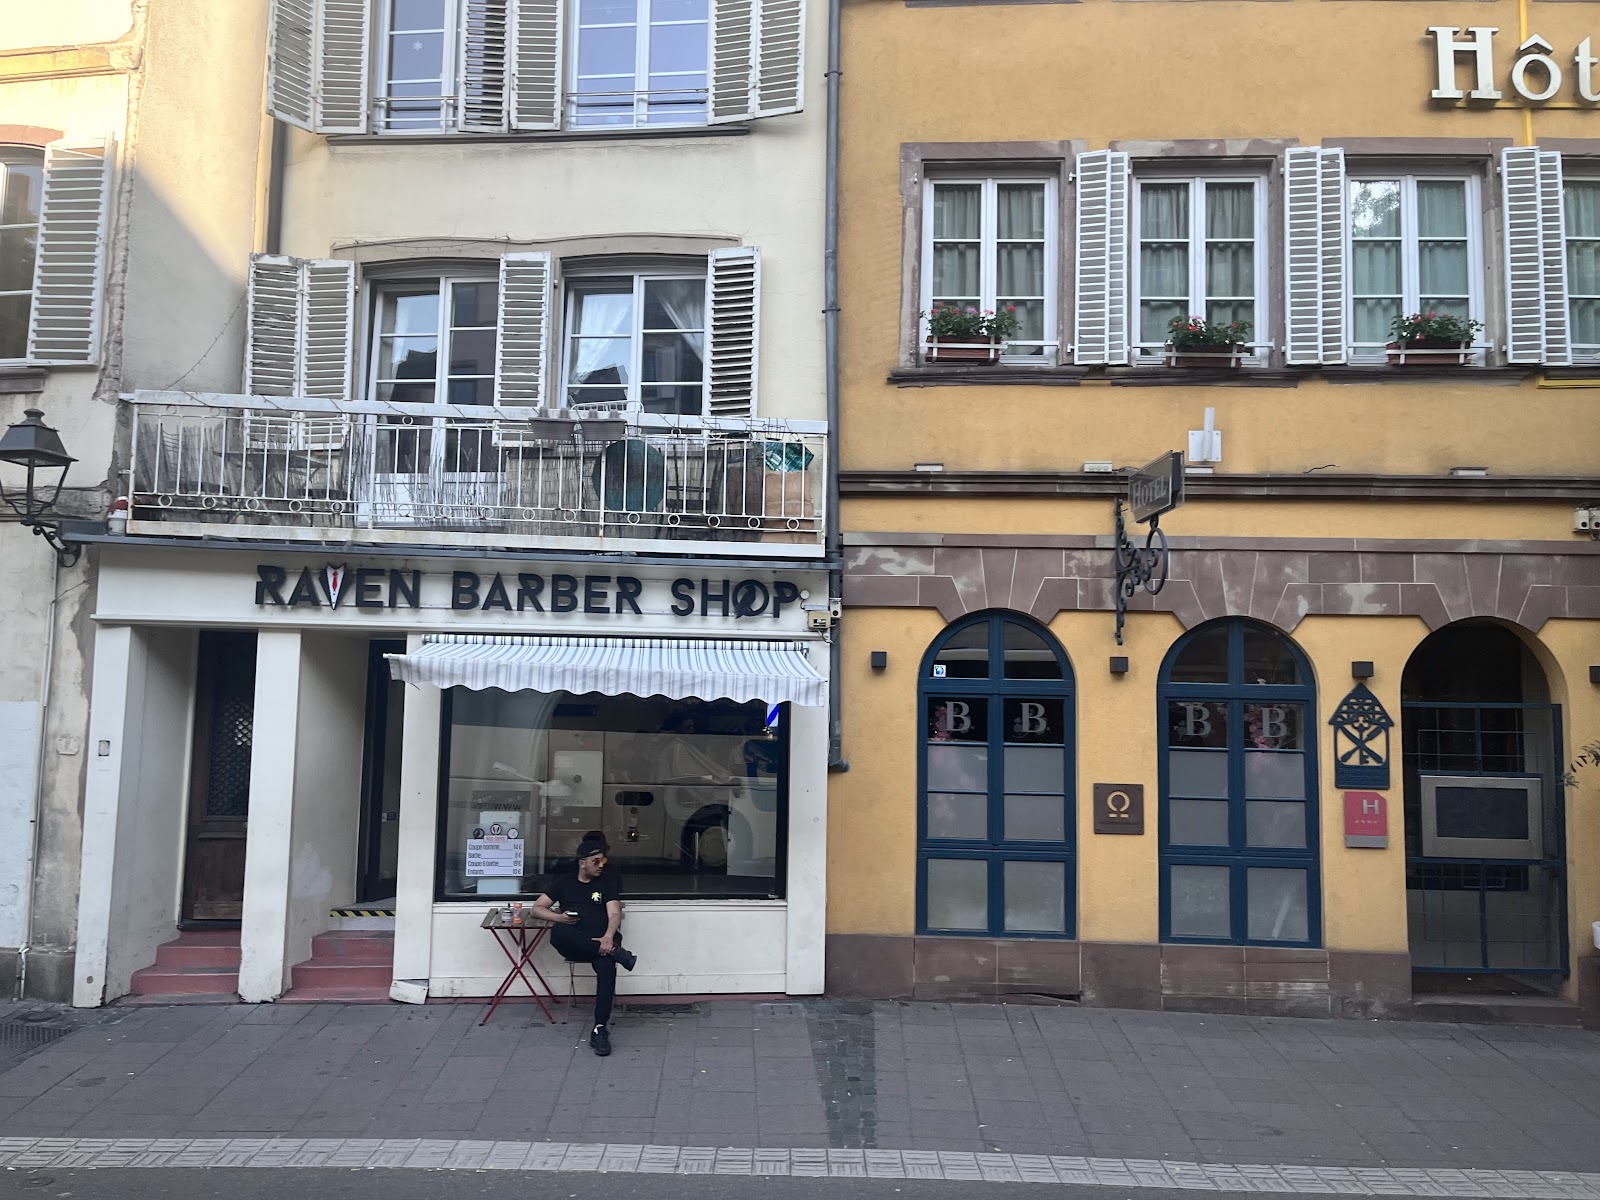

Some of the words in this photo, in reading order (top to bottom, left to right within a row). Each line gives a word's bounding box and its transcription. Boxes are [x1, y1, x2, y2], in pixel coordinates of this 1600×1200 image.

[254, 562, 421, 610] RAVEN
[451, 570, 643, 615] BARBER
[670, 577, 799, 619] SHOP
[945, 701, 971, 732] B
[1020, 702, 1047, 733] B
[1184, 705, 1212, 736] B
[1261, 707, 1288, 738] B
[1362, 799, 1380, 815] H
